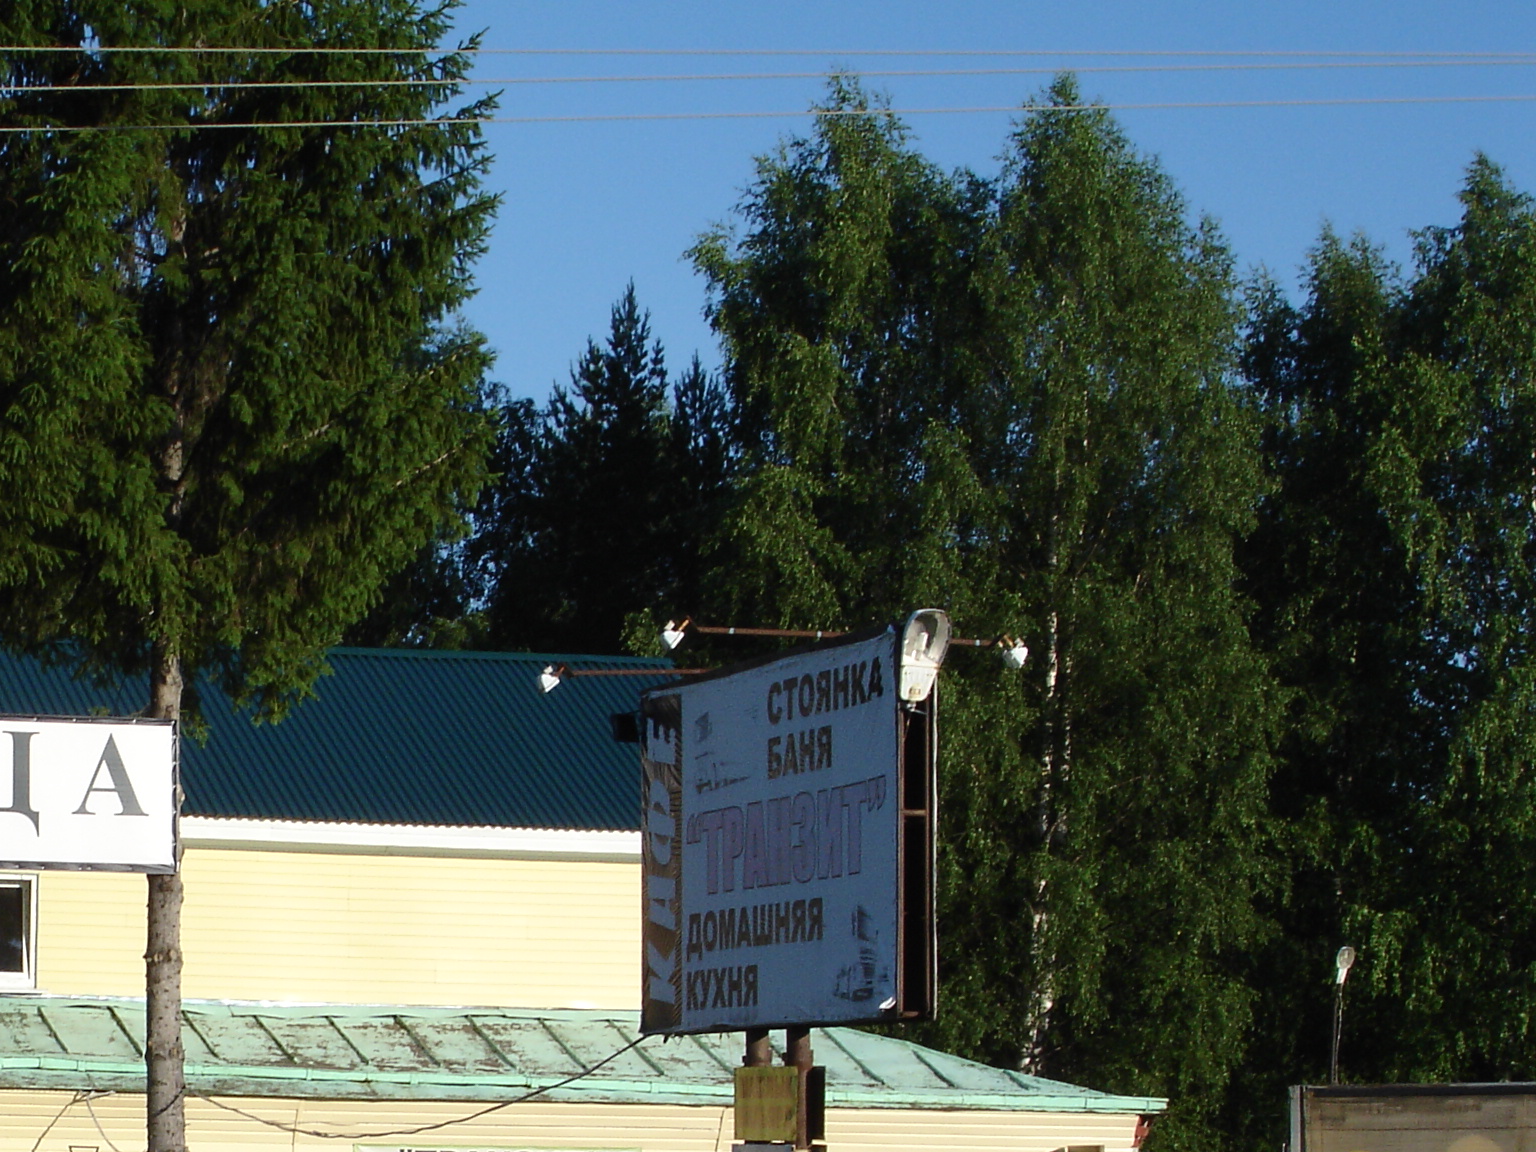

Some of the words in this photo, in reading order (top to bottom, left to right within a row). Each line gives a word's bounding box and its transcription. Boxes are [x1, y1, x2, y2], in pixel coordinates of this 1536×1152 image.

[767, 656, 884, 726] СТОЯНКА
[767, 725, 833, 780] БАНЯ
[686, 897, 824, 962] ДОМАШНЯЯ
[686, 963, 759, 1011] КУХНЯ
